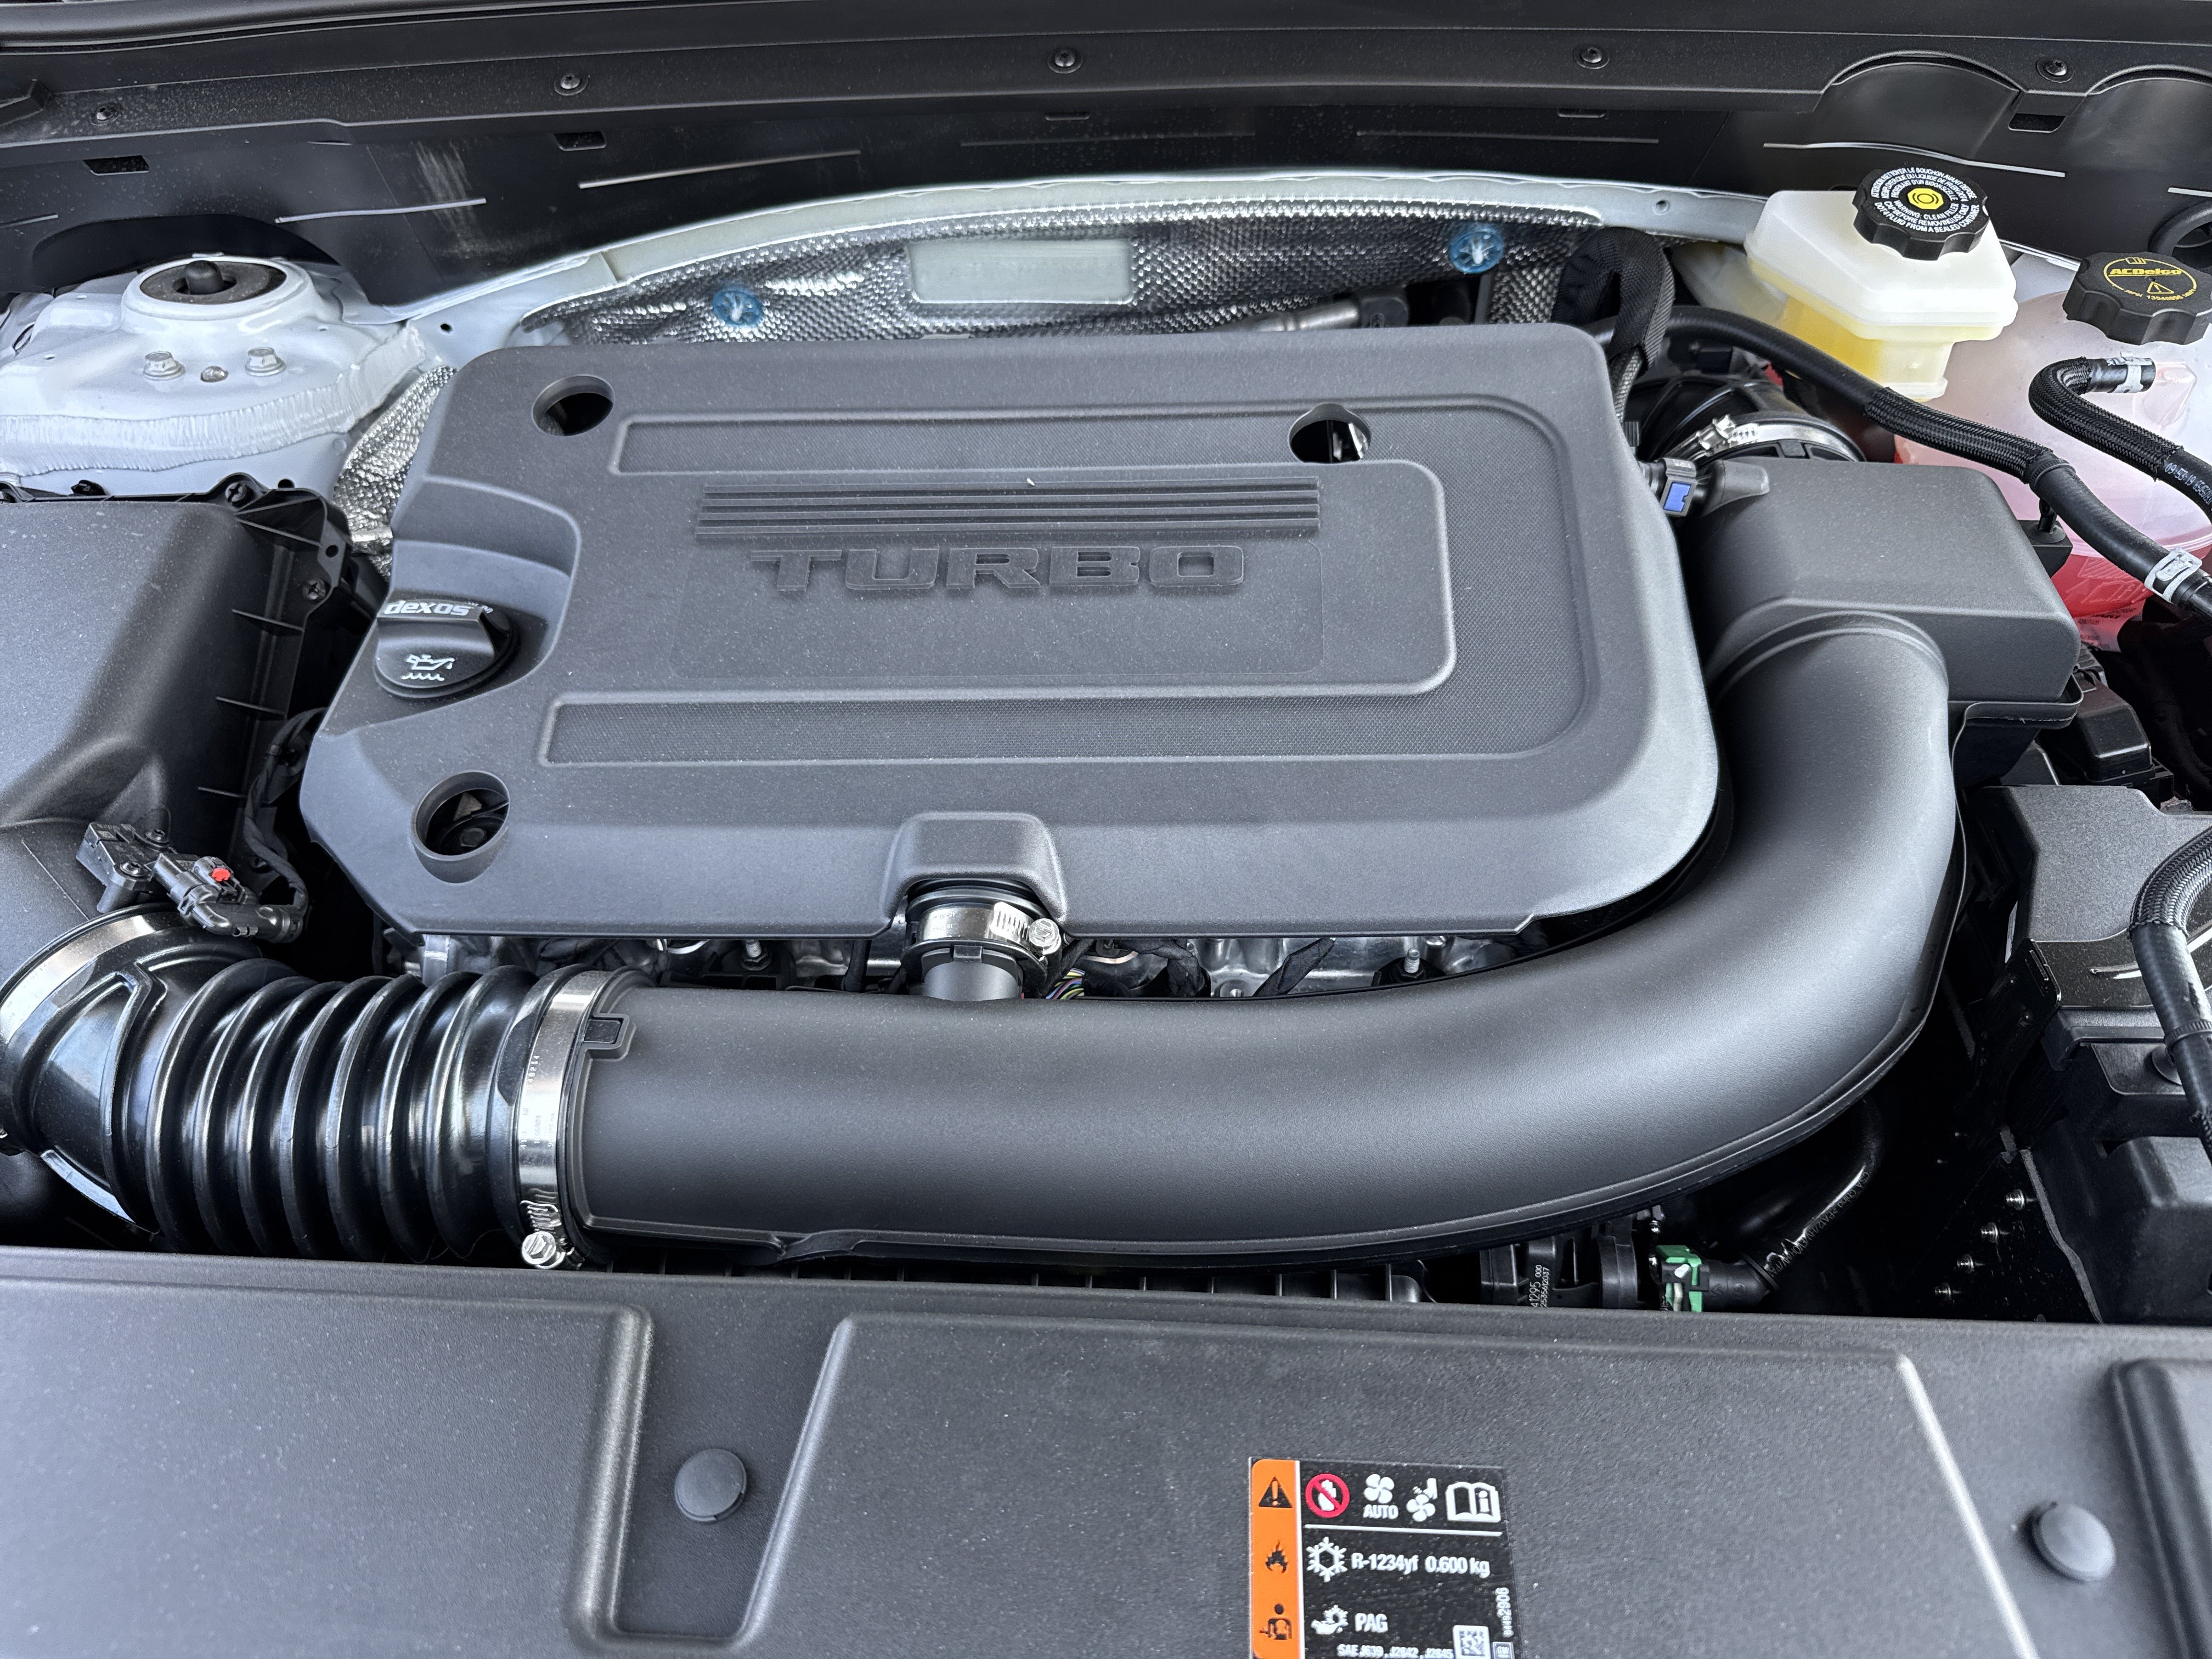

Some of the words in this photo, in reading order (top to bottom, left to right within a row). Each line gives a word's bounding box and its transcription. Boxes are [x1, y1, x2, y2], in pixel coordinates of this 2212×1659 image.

[1915, 173, 1938, 182] LIQUIDE
[1944, 181, 1961, 192] FREIN
[1916, 167, 1945, 177] BOUCHON
[1943, 174, 1963, 185] AVANT
[1883, 201, 1897, 210] CAP
[1892, 209, 1918, 224] BEFORE
[1918, 218, 1954, 226] REMOVING
[1953, 213, 1964, 222] USE
[1959, 204, 1970, 215] ONLY
[1944, 203, 1959, 217] FILLER
[1886, 213, 1906, 225] FLUID
[1905, 222, 1927, 232] FROM
[1934, 224, 1960, 233] SEALED
[750, 546, 1244, 591] TURBO
[1363, 1504, 1399, 1520] AUTO
[1351, 1553, 1419, 1575] R-1234yf
[1425, 1555, 1468, 1575] 0.600
[1470, 1557, 1491, 1579] kg
[1355, 1612, 1388, 1633] PAG
[1337, 1644, 1359, 1657] SAE
